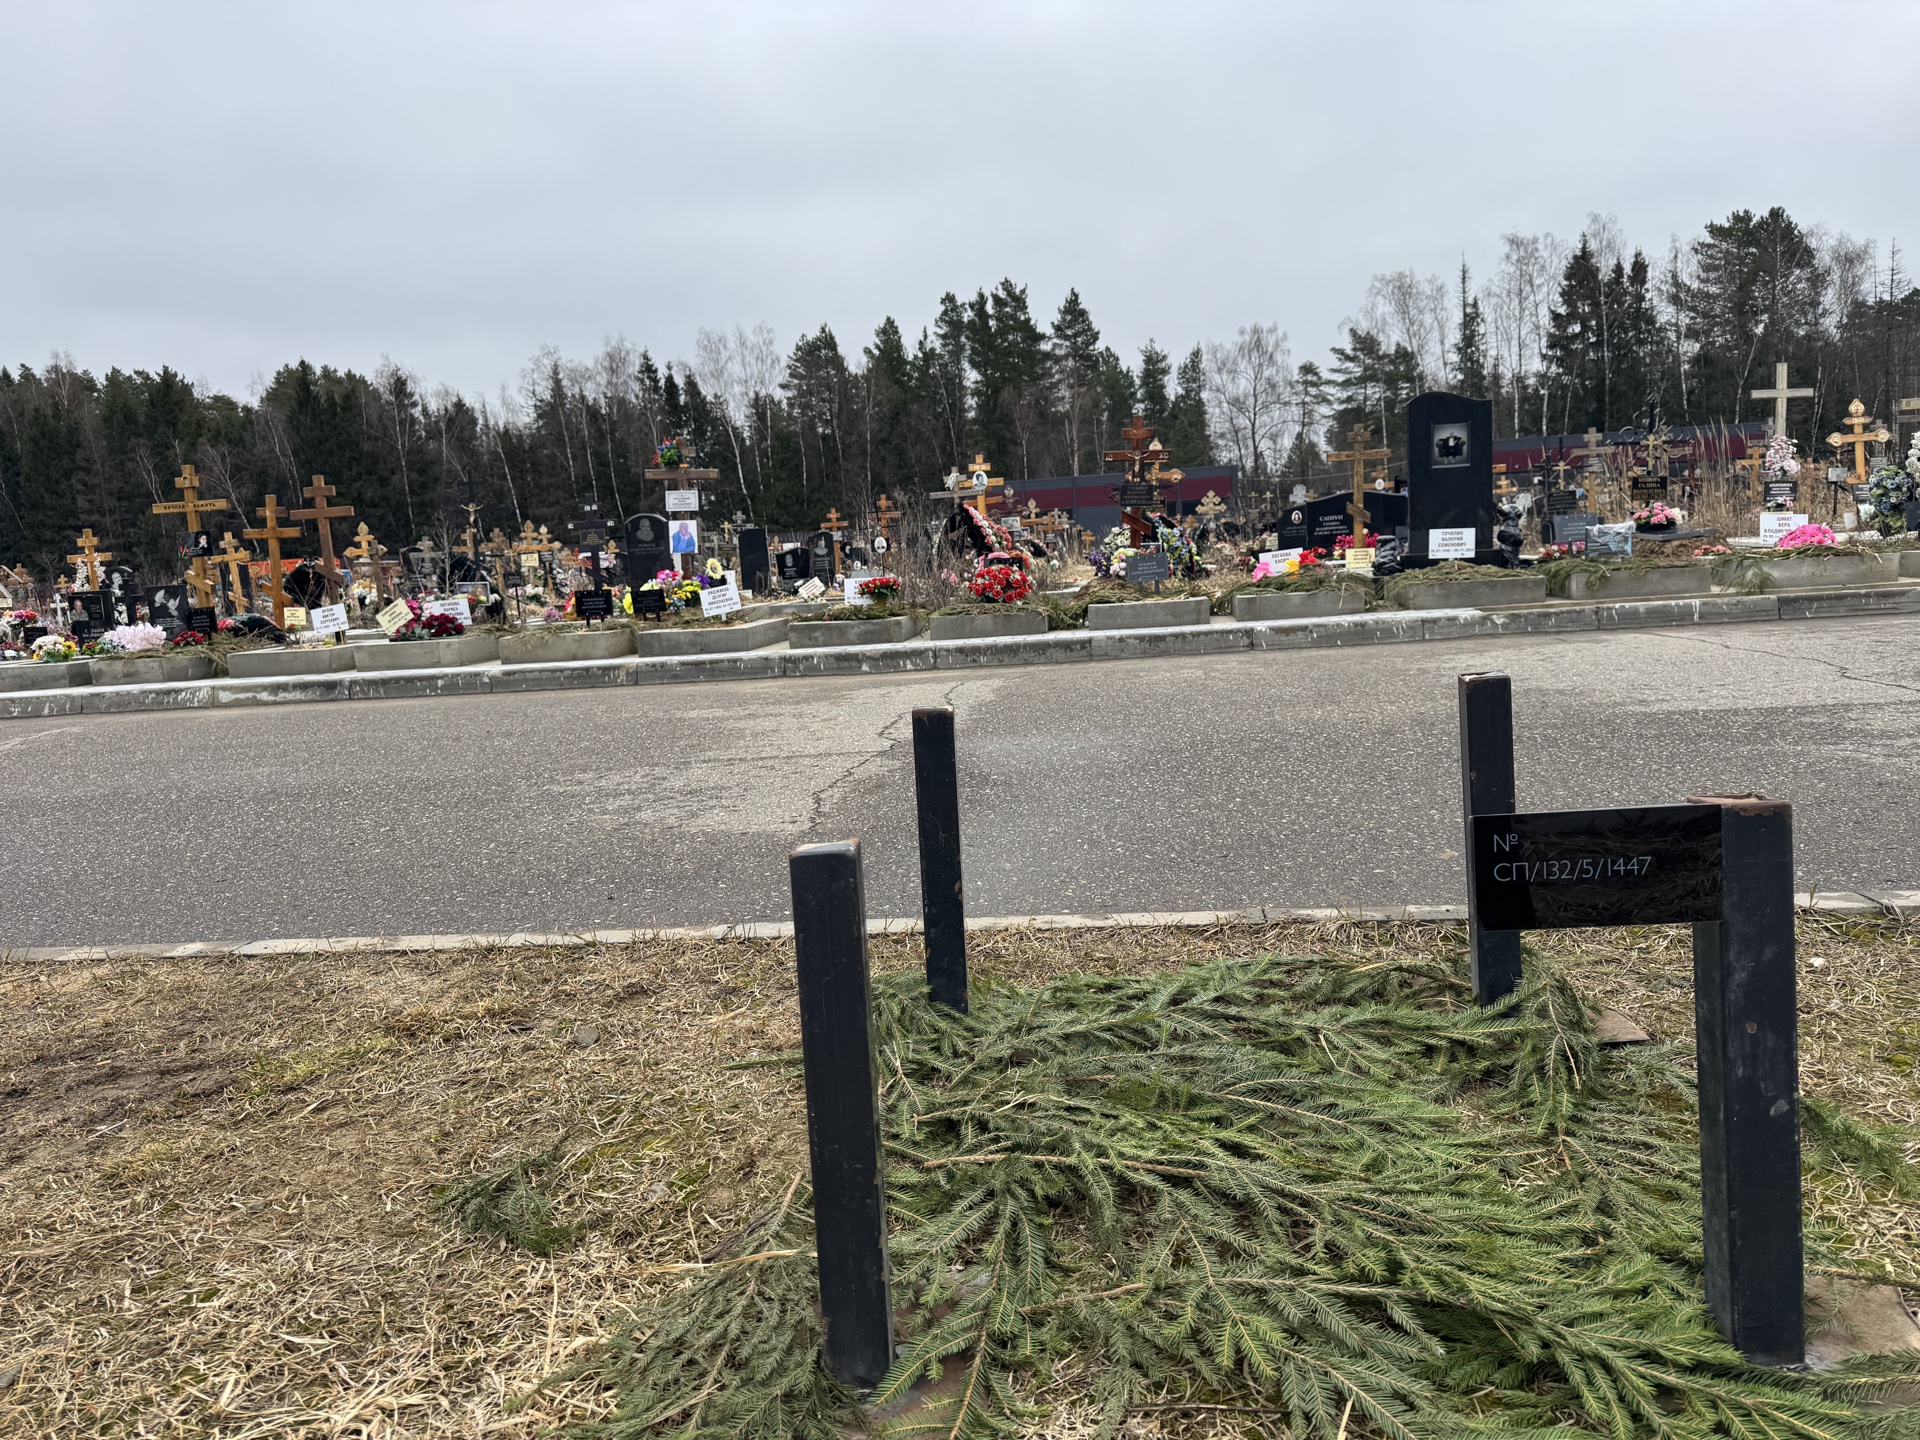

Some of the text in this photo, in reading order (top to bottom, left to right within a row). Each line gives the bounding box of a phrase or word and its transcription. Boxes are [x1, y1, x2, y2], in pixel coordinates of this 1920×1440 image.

[708, 597, 734, 606] НИКОЛАЕВНА
[320, 617, 340, 625] СЕРГЕЕВИЧ
[1493, 833, 1519, 853] №
[1493, 855, 1652, 882] СП/132/5/1447
